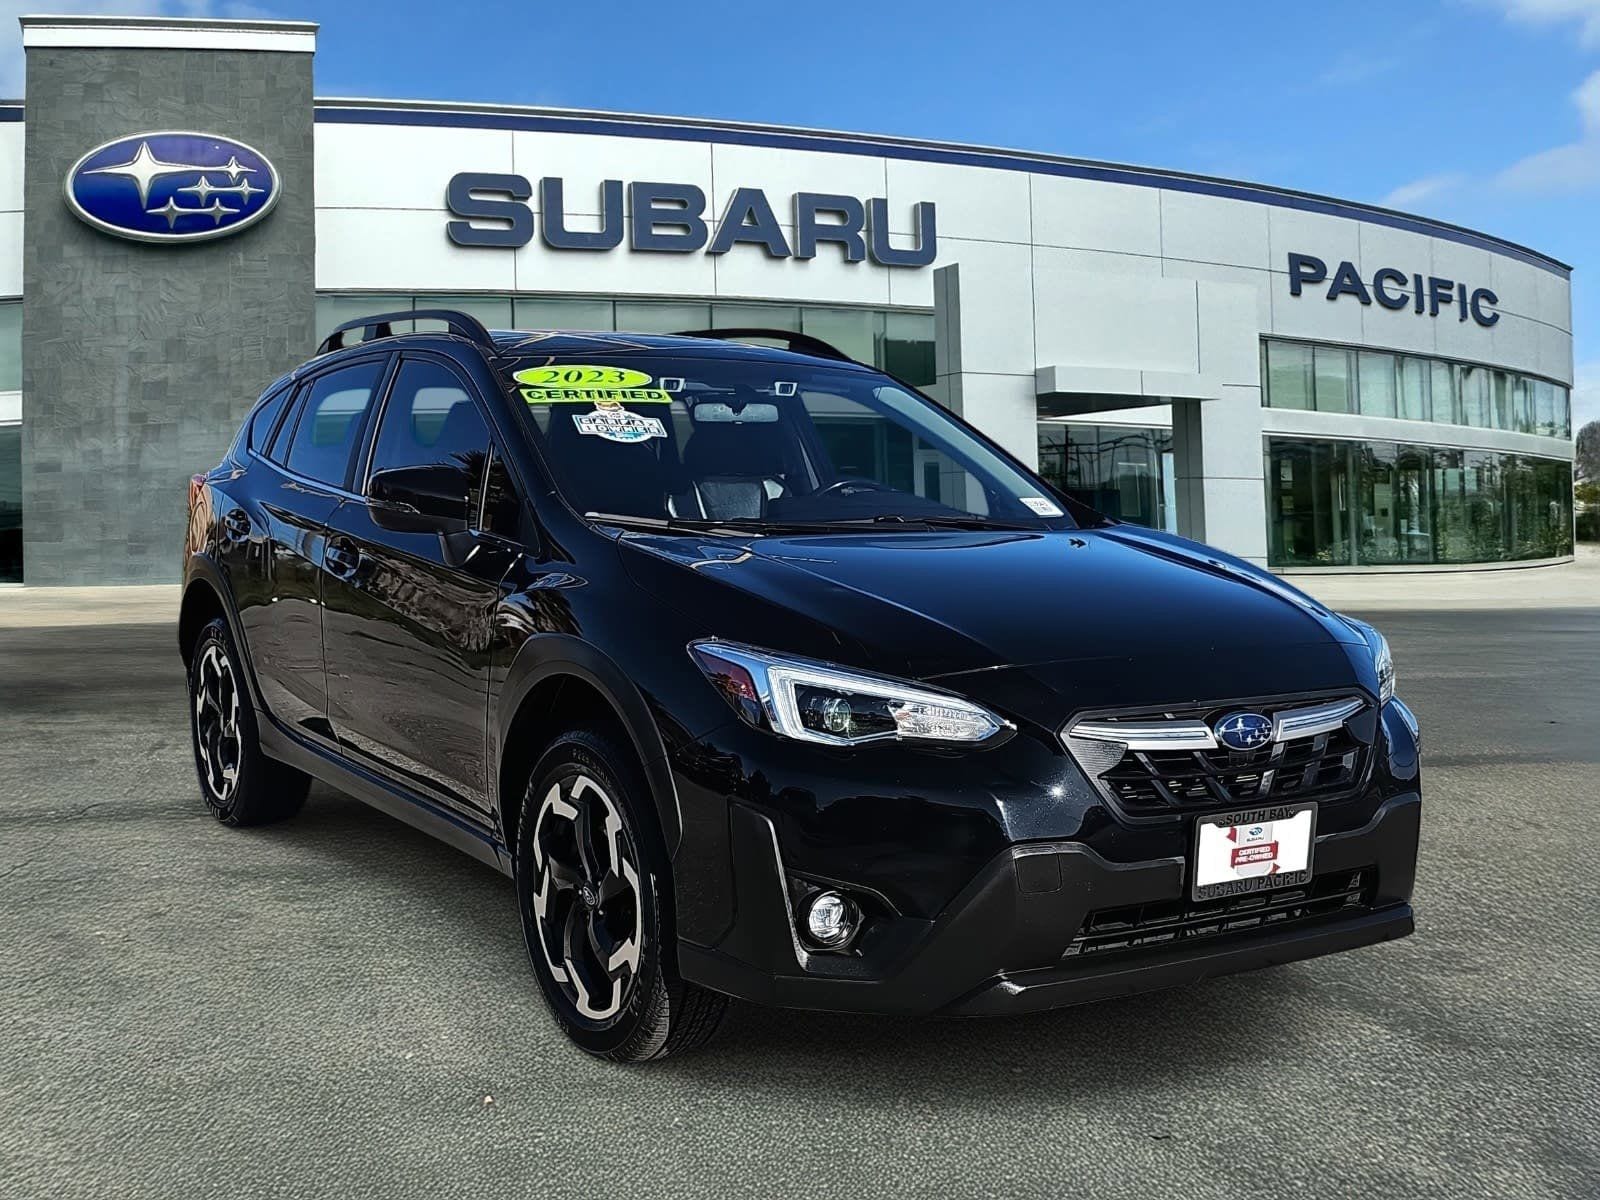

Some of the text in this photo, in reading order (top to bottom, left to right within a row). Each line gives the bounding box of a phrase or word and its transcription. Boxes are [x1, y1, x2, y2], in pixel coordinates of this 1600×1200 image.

[447, 172, 938, 268] SUBARU
[1288, 252, 1501, 328] PACIFIC
[541, 370, 626, 384] 2023
[526, 389, 664, 401] CERTIFIED
[579, 417, 657, 428] CARFAX
[1226, 807, 1289, 825] SOUTH BAY
[1235, 852, 1273, 864] PRE-OWNED
[1238, 846, 1271, 856] CERTIFIED
[1197, 870, 1307, 899] SUBARU PACIFIC
